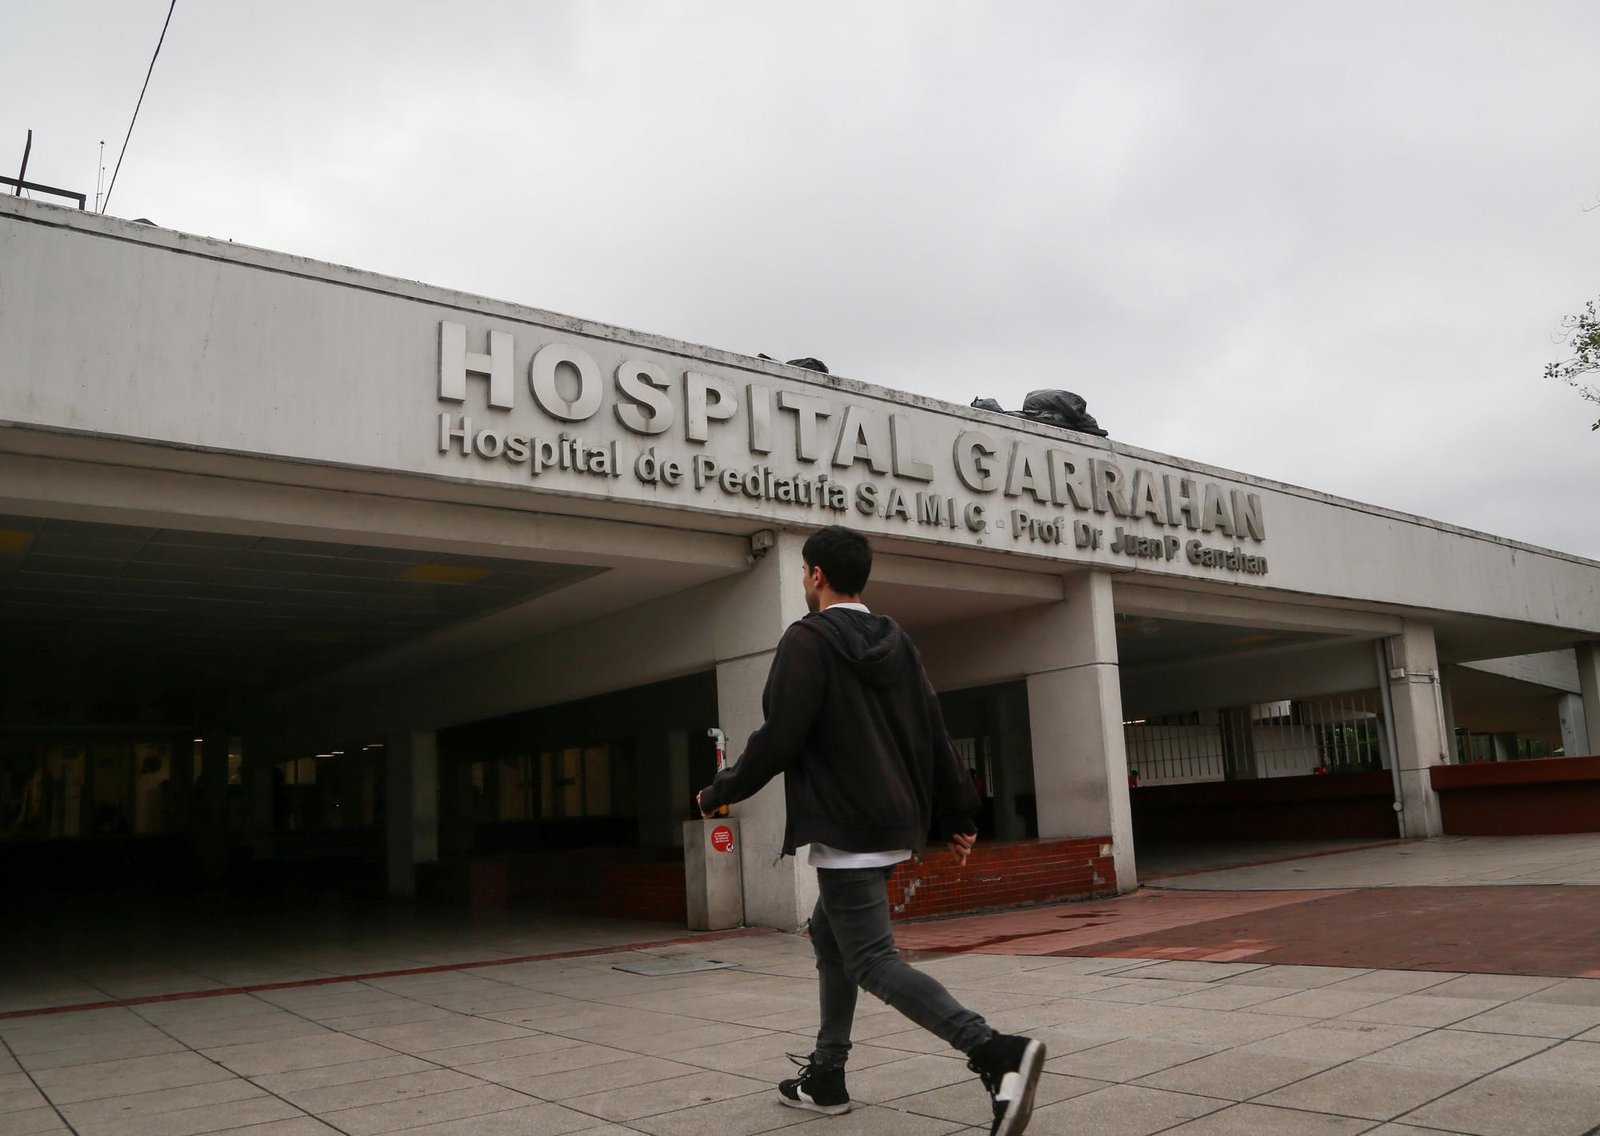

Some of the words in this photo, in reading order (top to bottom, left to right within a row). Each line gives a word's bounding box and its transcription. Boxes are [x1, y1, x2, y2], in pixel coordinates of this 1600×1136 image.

[438, 320, 933, 482] HOSPITAL
[953, 430, 1266, 542] GARRAHAN
[438, 412, 623, 478] Hospital
[634, 447, 683, 487] de
[1111, 526, 1163, 561] Juan
[1186, 539, 1268, 575] Garrahan
